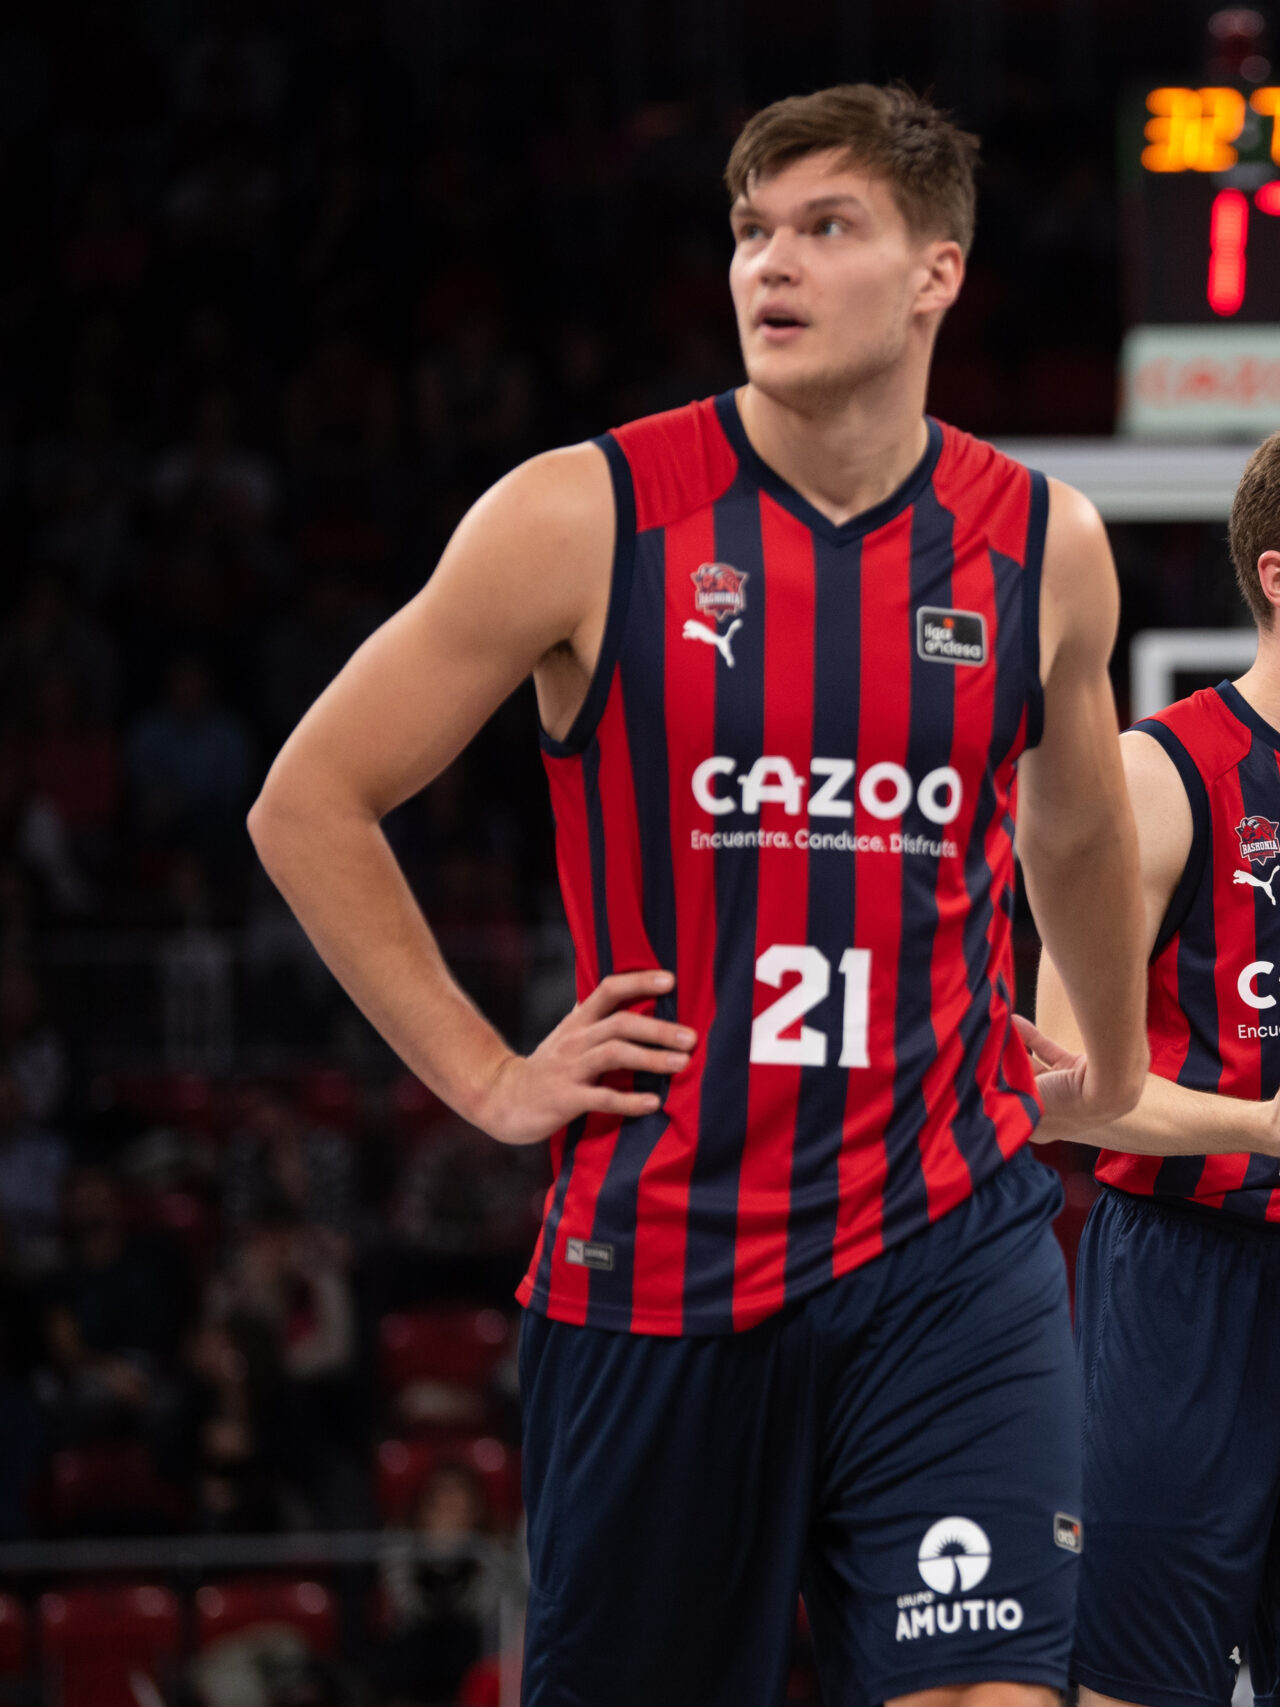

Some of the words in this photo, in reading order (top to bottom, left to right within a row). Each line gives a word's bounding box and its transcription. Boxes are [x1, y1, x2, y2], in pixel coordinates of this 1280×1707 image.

[691, 755, 963, 825] CAZOO
[691, 829, 792, 850] Encuentra.
[794, 829, 885, 852] Conduce.
[750, 944, 872, 1068] 21
[896, 1598, 1023, 1641] AMUTIO
